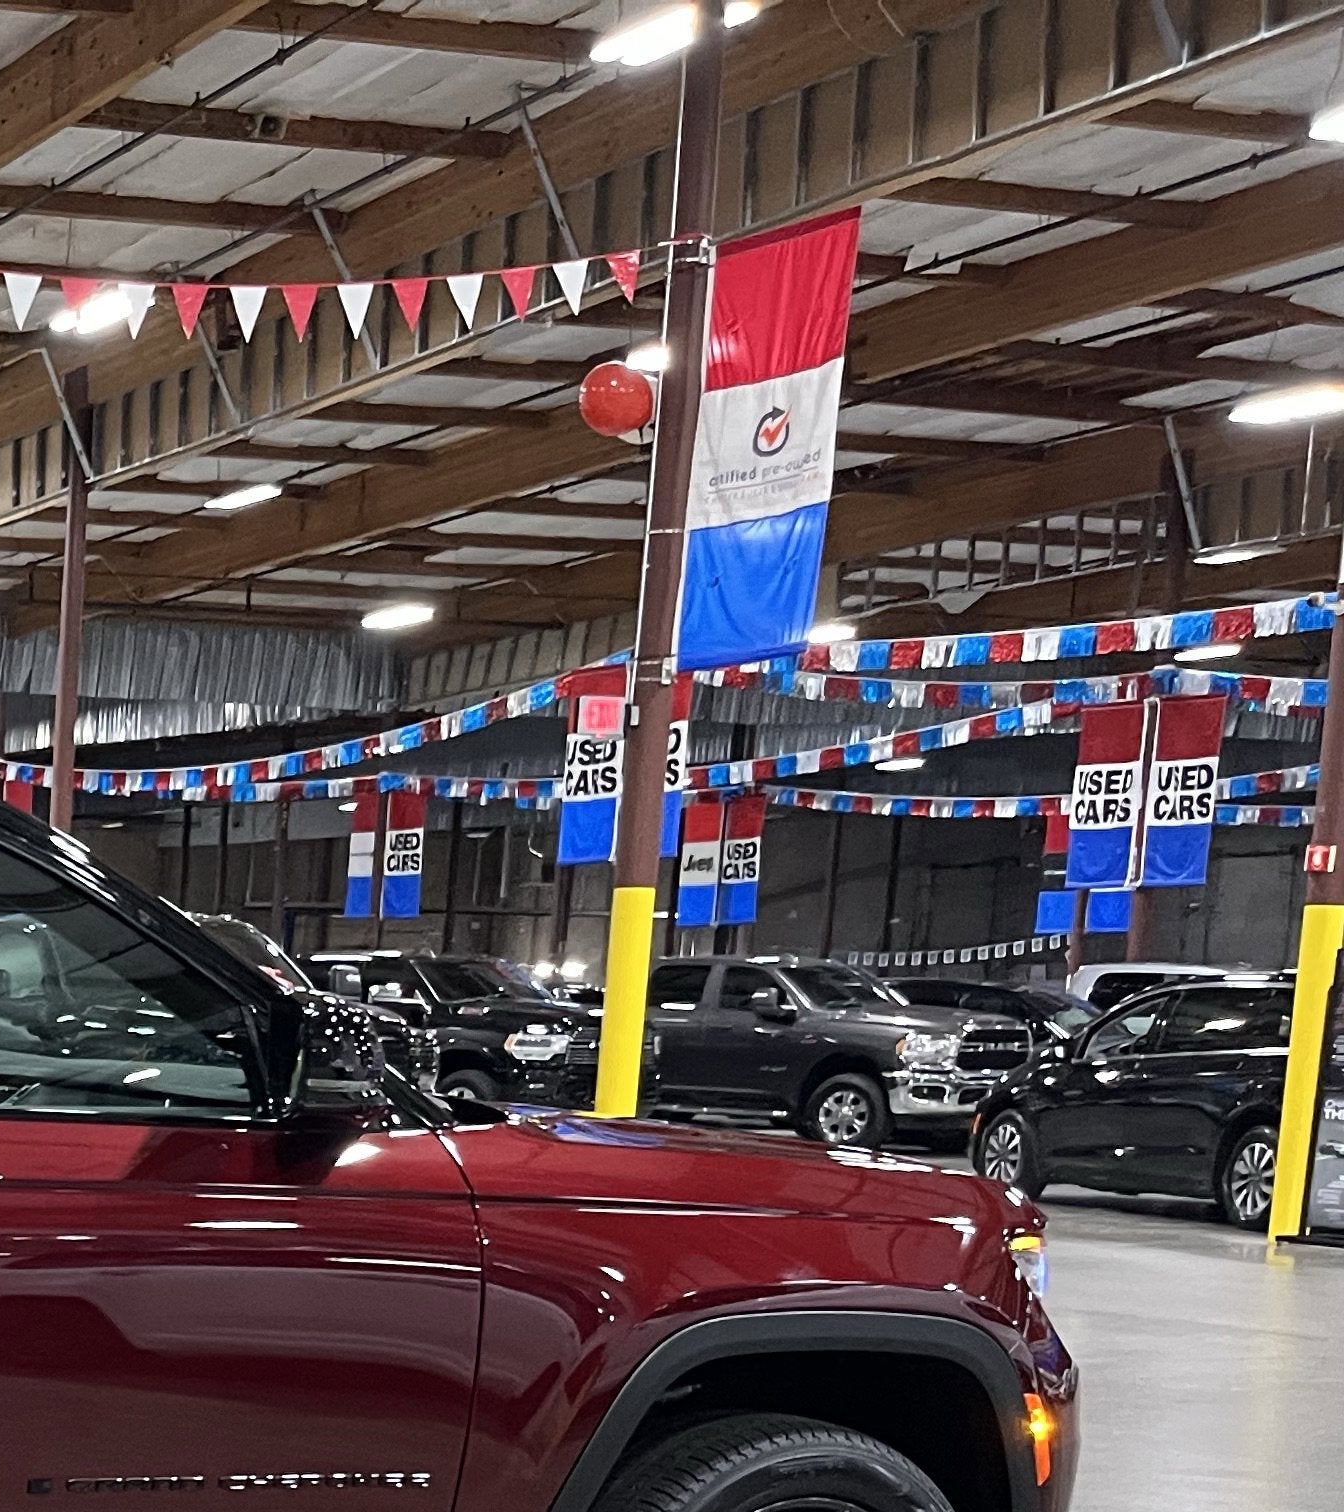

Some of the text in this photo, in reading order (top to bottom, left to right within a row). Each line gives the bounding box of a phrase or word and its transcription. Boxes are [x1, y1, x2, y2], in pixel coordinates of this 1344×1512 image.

[709, 448, 822, 487] ctified pre-owed
[567, 739, 617, 765] USED
[565, 766, 617, 796] CARS
[1078, 769, 1133, 795] USED
[1158, 764, 1214, 792] USED
[1075, 797, 1131, 824] CARS
[1153, 793, 1212, 820] CARS
[390, 833, 420, 851] USED
[727, 842, 757, 860] USED
